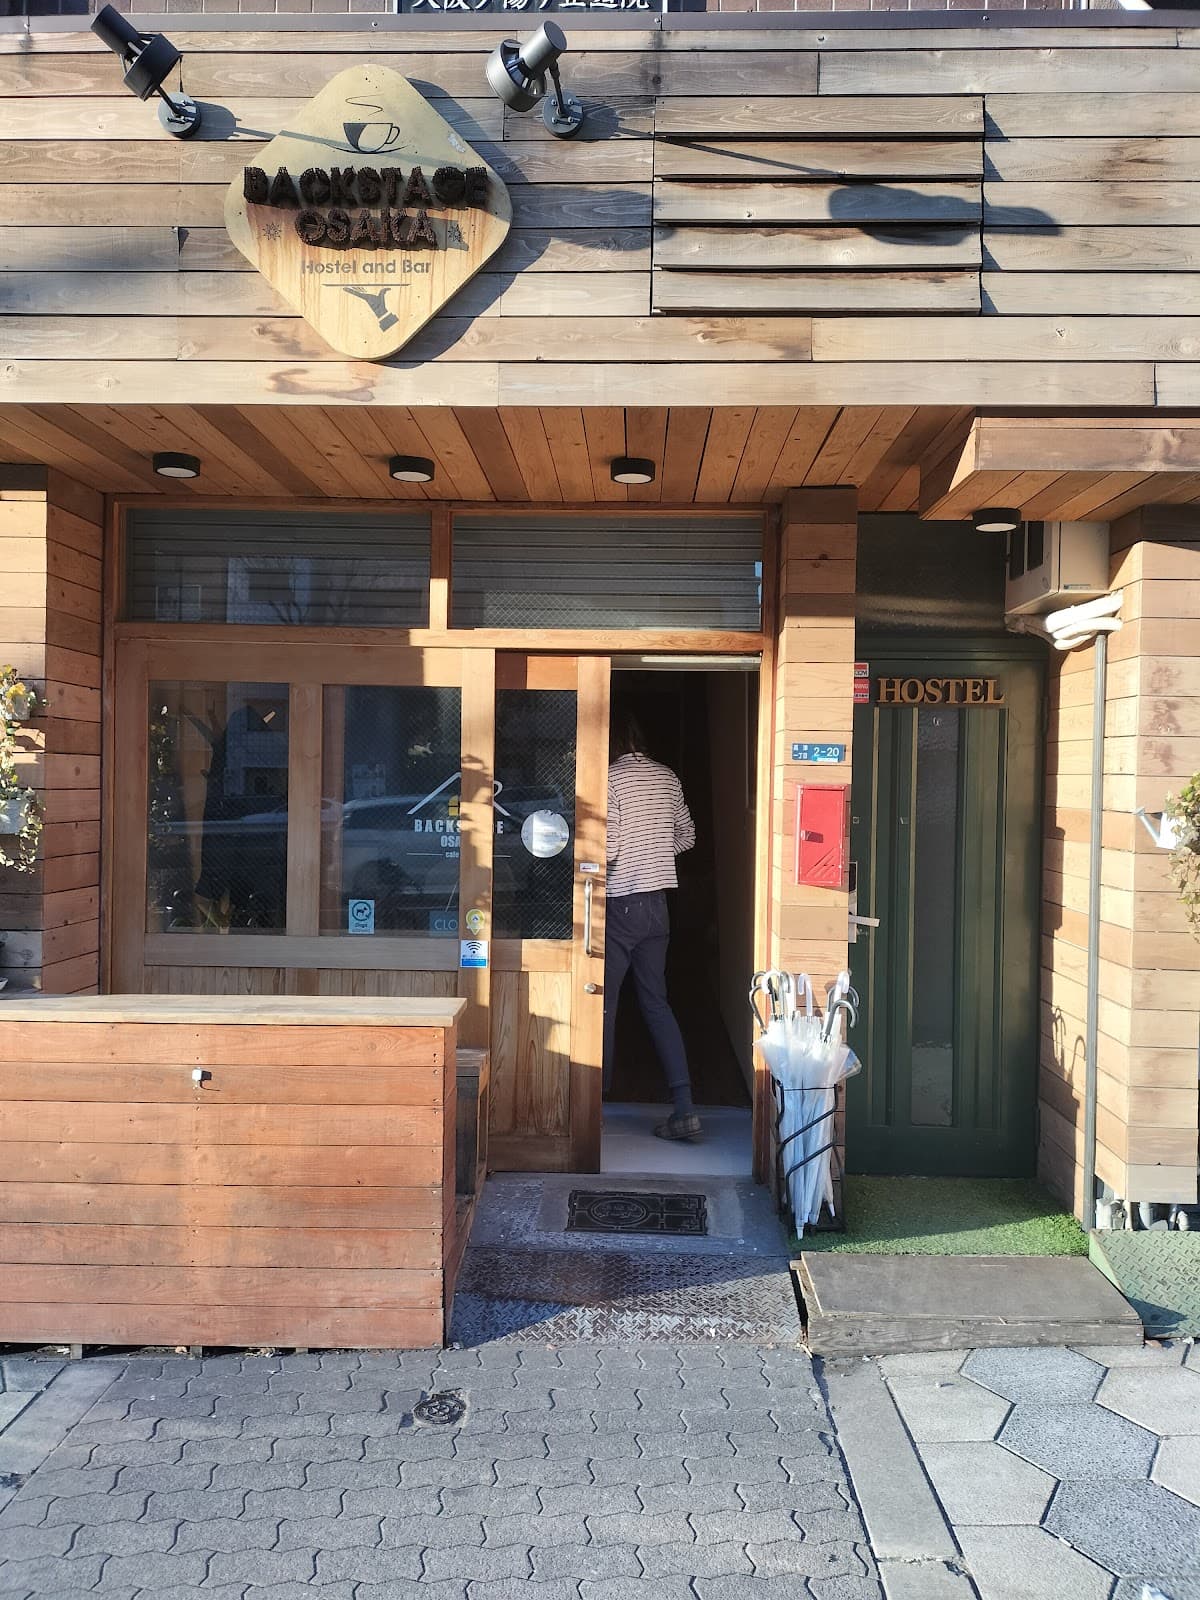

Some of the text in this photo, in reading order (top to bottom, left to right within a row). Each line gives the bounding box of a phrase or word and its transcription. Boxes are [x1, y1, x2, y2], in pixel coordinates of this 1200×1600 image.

[243, 166, 489, 209] BACKSTAGE
[295, 208, 438, 247] OSAKA
[302, 260, 431, 274] Hostel and Bar
[876, 678, 1005, 704] HOSTEL
[814, 747, 840, 757] 2-20
[414, 819, 504, 834] BACKSE
[434, 919, 458, 931] CLO
